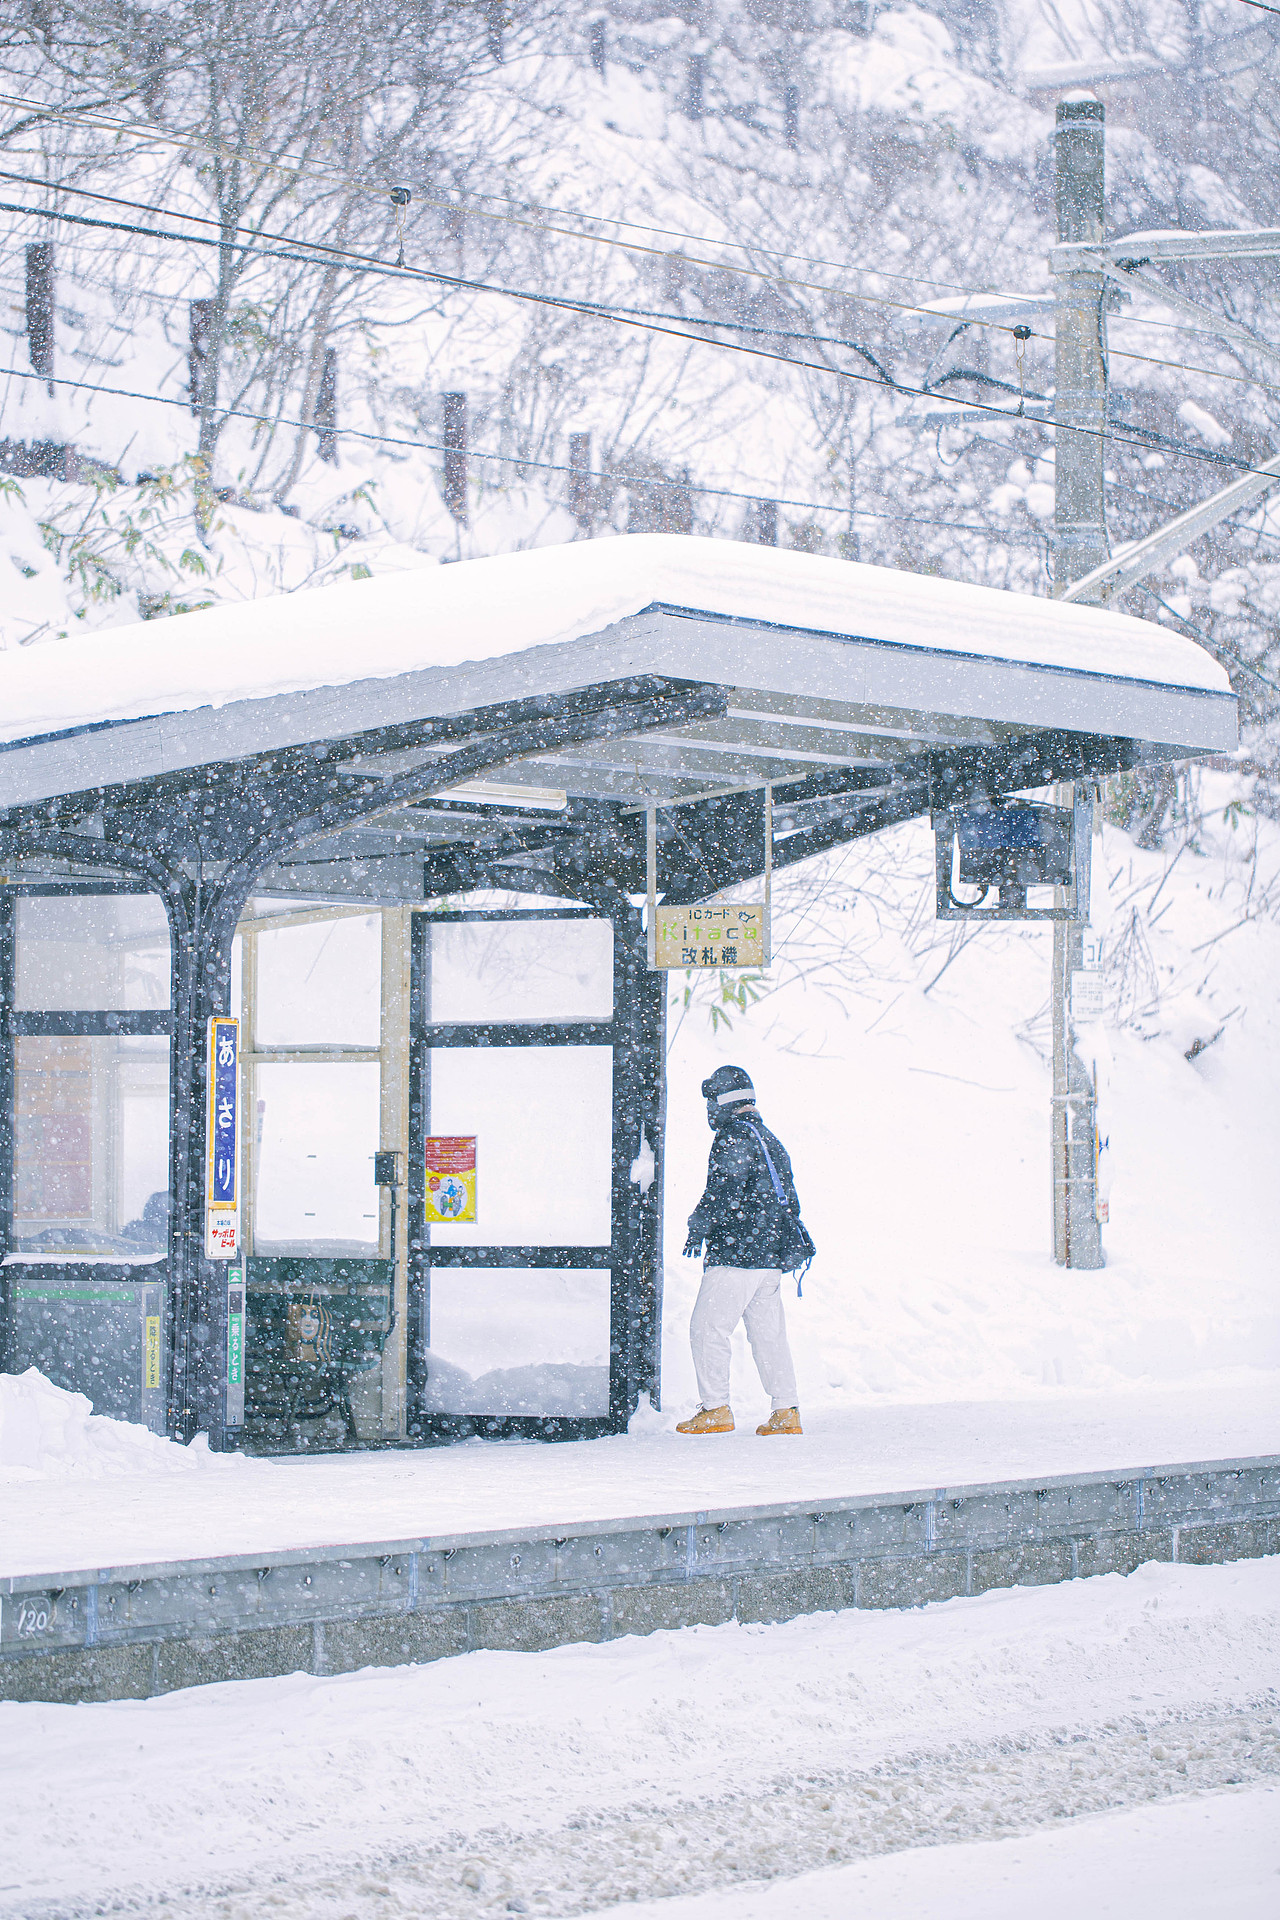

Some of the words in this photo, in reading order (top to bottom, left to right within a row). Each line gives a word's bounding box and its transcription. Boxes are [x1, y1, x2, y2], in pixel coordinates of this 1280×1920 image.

[689, 909, 730, 920] ICカード
[662, 922, 757, 941] Kitaca
[682, 946, 738, 965] 改札機
[218, 1035, 234, 1191] あさり
[212, 1229, 235, 1238] サッポロ
[221, 1239, 235, 1248] ビール
[231, 1323, 240, 1381] 乗るとき
[232, 1415, 237, 1424] 3
[18, 1609, 47, 1632] 120
